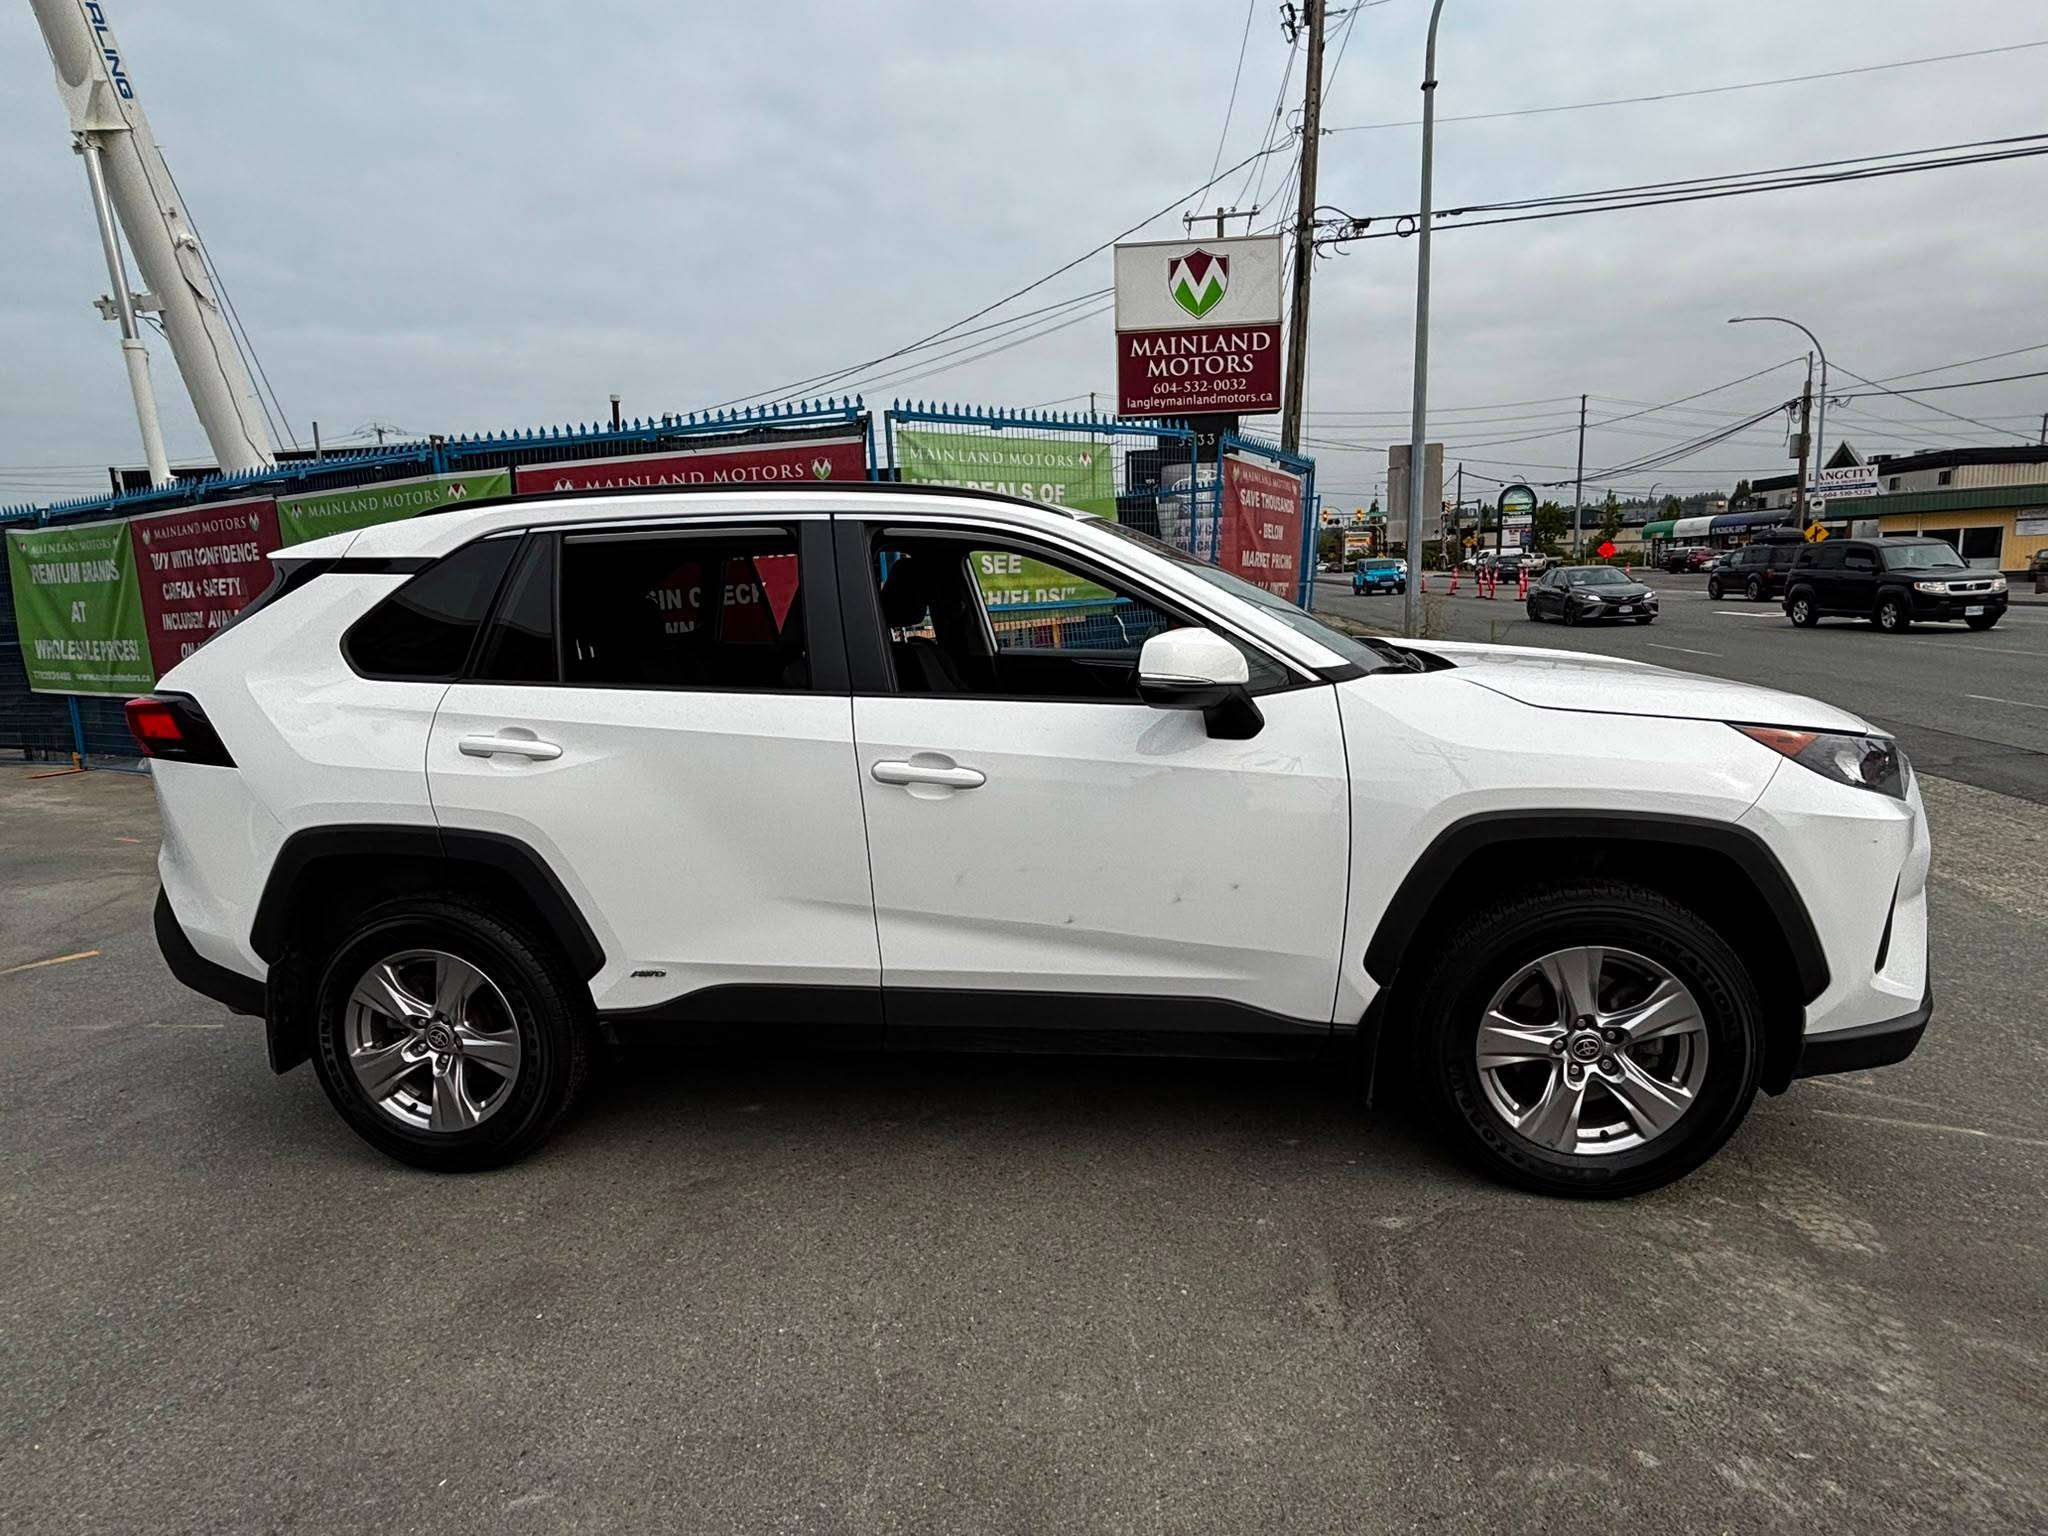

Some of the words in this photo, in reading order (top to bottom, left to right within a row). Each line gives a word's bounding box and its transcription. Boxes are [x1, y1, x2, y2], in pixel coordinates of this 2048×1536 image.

[85, 0, 133, 99] RLING
[1130, 332, 1270, 357] MAINLAND
[1147, 354, 1253, 377] MOTORS
[1153, 378, 1247, 394] 604-532-0032
[1127, 393, 1272, 410] langleymainlandmotors.ca
[910, 446, 1004, 465] MAINLAND
[1009, 454, 1073, 468] MOTORS
[713, 463, 804, 483] MOTORS
[307, 497, 378, 518] MAINLAND
[382, 488, 440, 508] MOTORS
[1040, 483, 1066, 504] OF
[1240, 488, 1260, 508] SAVE
[1261, 491, 1294, 514] THOUSANDS
[153, 523, 200, 540] MAINLAND
[201, 516, 247, 533] MOTORS
[170, 549, 194, 569] WITH
[194, 542, 260, 566] CONFIDENCE
[981, 554, 1022, 575] SEE
[71, 601, 87, 623] AT
